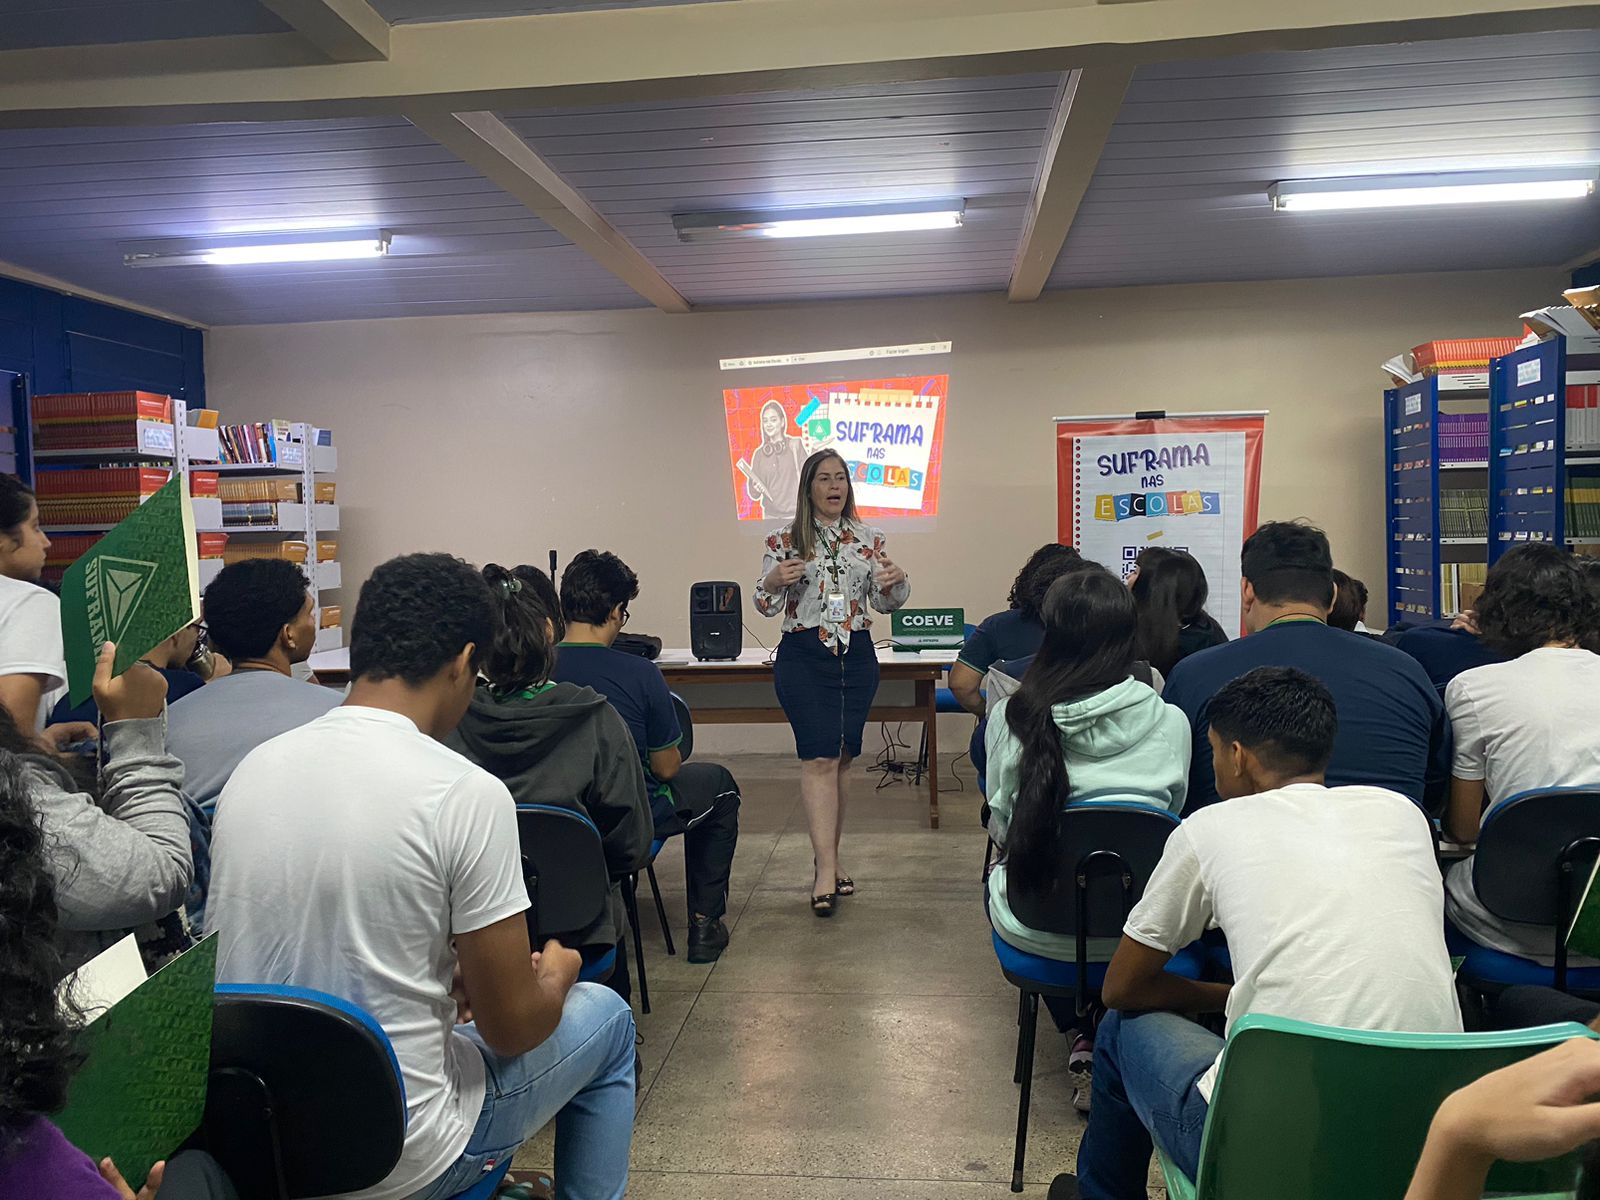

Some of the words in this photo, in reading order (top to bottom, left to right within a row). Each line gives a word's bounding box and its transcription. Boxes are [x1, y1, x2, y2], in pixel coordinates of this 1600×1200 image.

[835, 420, 924, 447] SUFRAMA
[1097, 442, 1211, 477] SUFRAMA
[848, 462, 920, 487] SCOLAS
[1100, 491, 1213, 517] ESCOLAS
[85, 556, 106, 664] SUFRAM
[901, 615, 954, 627] COEVE
